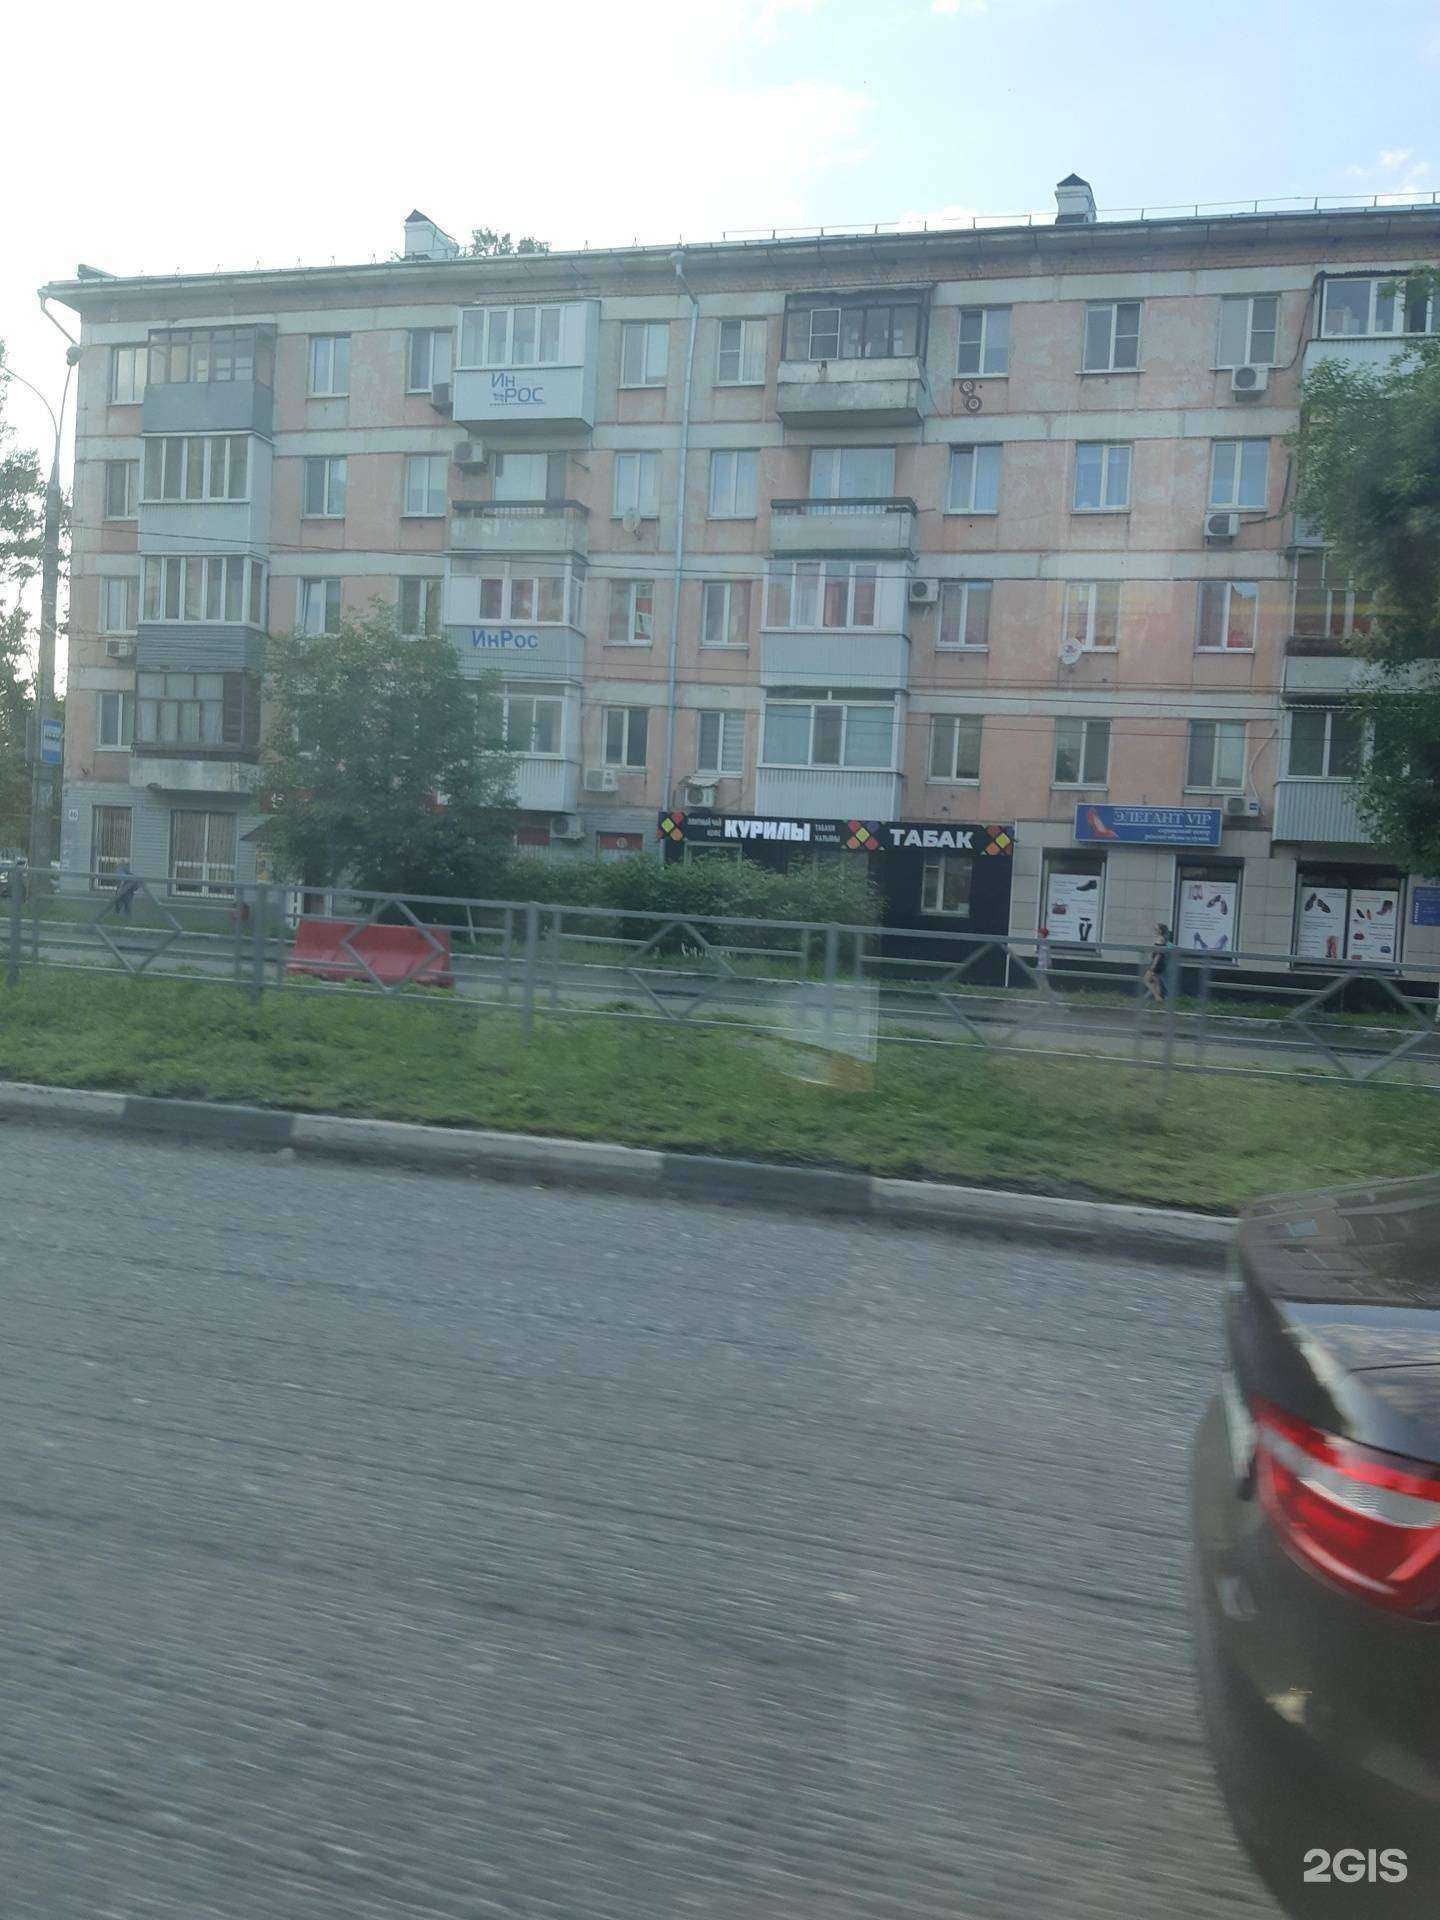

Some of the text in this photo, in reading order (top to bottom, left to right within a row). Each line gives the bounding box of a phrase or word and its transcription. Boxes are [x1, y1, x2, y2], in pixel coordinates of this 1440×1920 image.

[504, 387, 544, 403] РОС
[472, 629, 539, 649] ИнРос
[1185, 812, 1212, 825] VIP
[724, 819, 811, 842] КУРИЛЫ
[889, 828, 974, 849] ТАБАК
